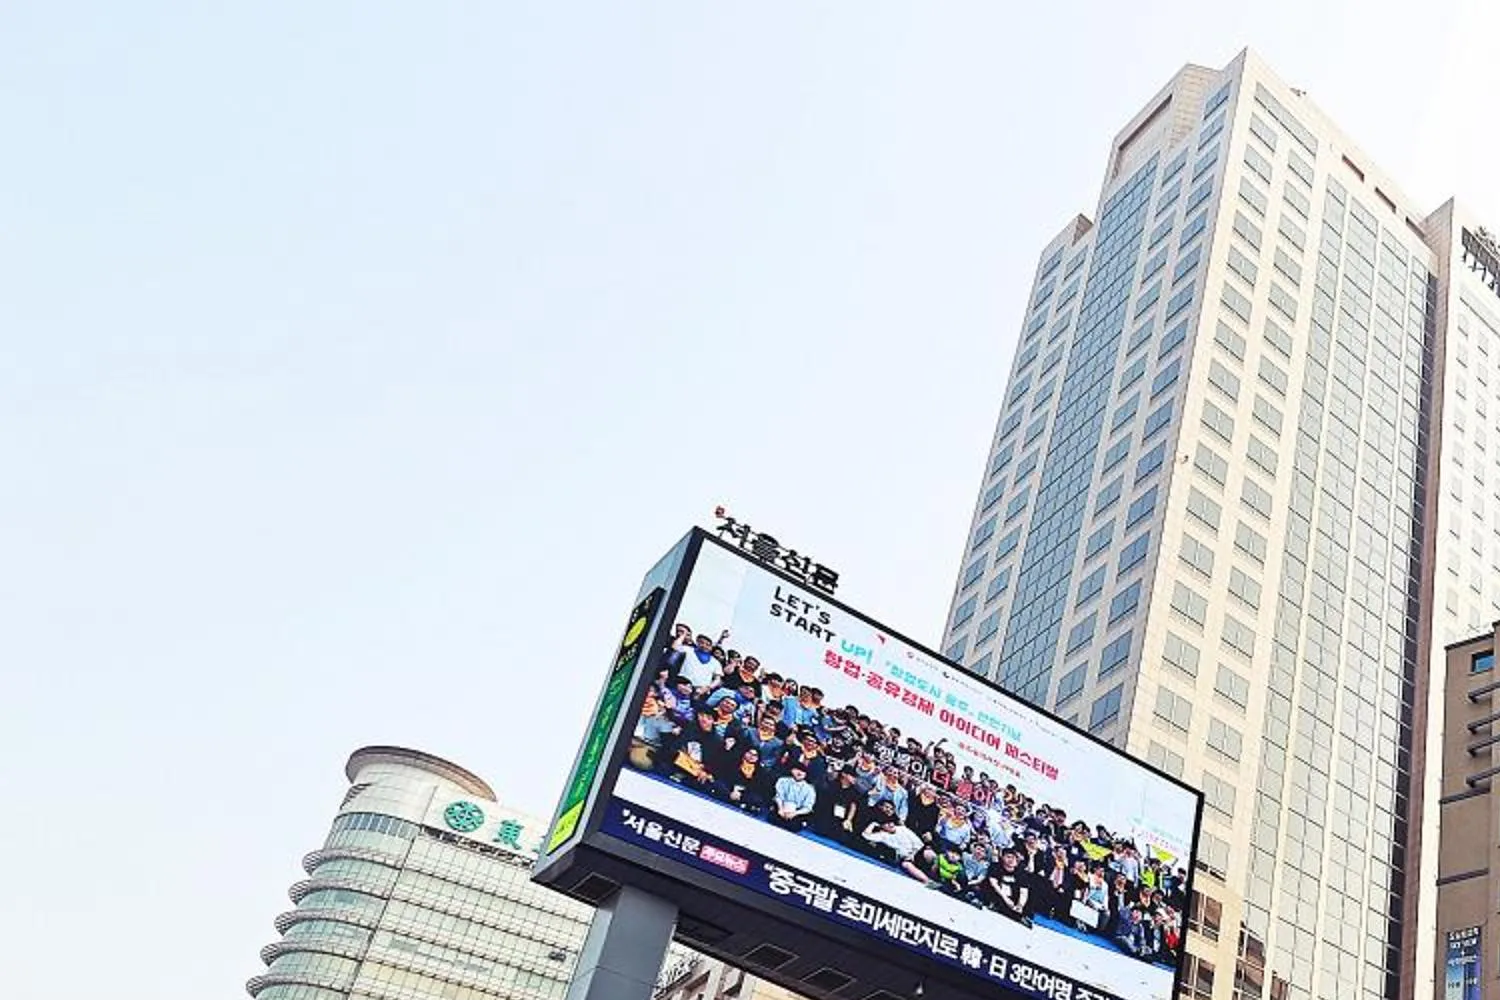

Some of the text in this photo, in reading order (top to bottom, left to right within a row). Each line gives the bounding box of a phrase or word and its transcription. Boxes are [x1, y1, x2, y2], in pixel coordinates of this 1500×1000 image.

[716, 517, 839, 595] 서울신문
[770, 603, 837, 643] START
[774, 586, 831, 625] LET'S
[938, 709, 1000, 751] 아이디어
[1004, 741, 1060, 781] 페스티벌
[624, 814, 699, 856] 서울신문
[836, 895, 959, 960] 초미세먼지로
